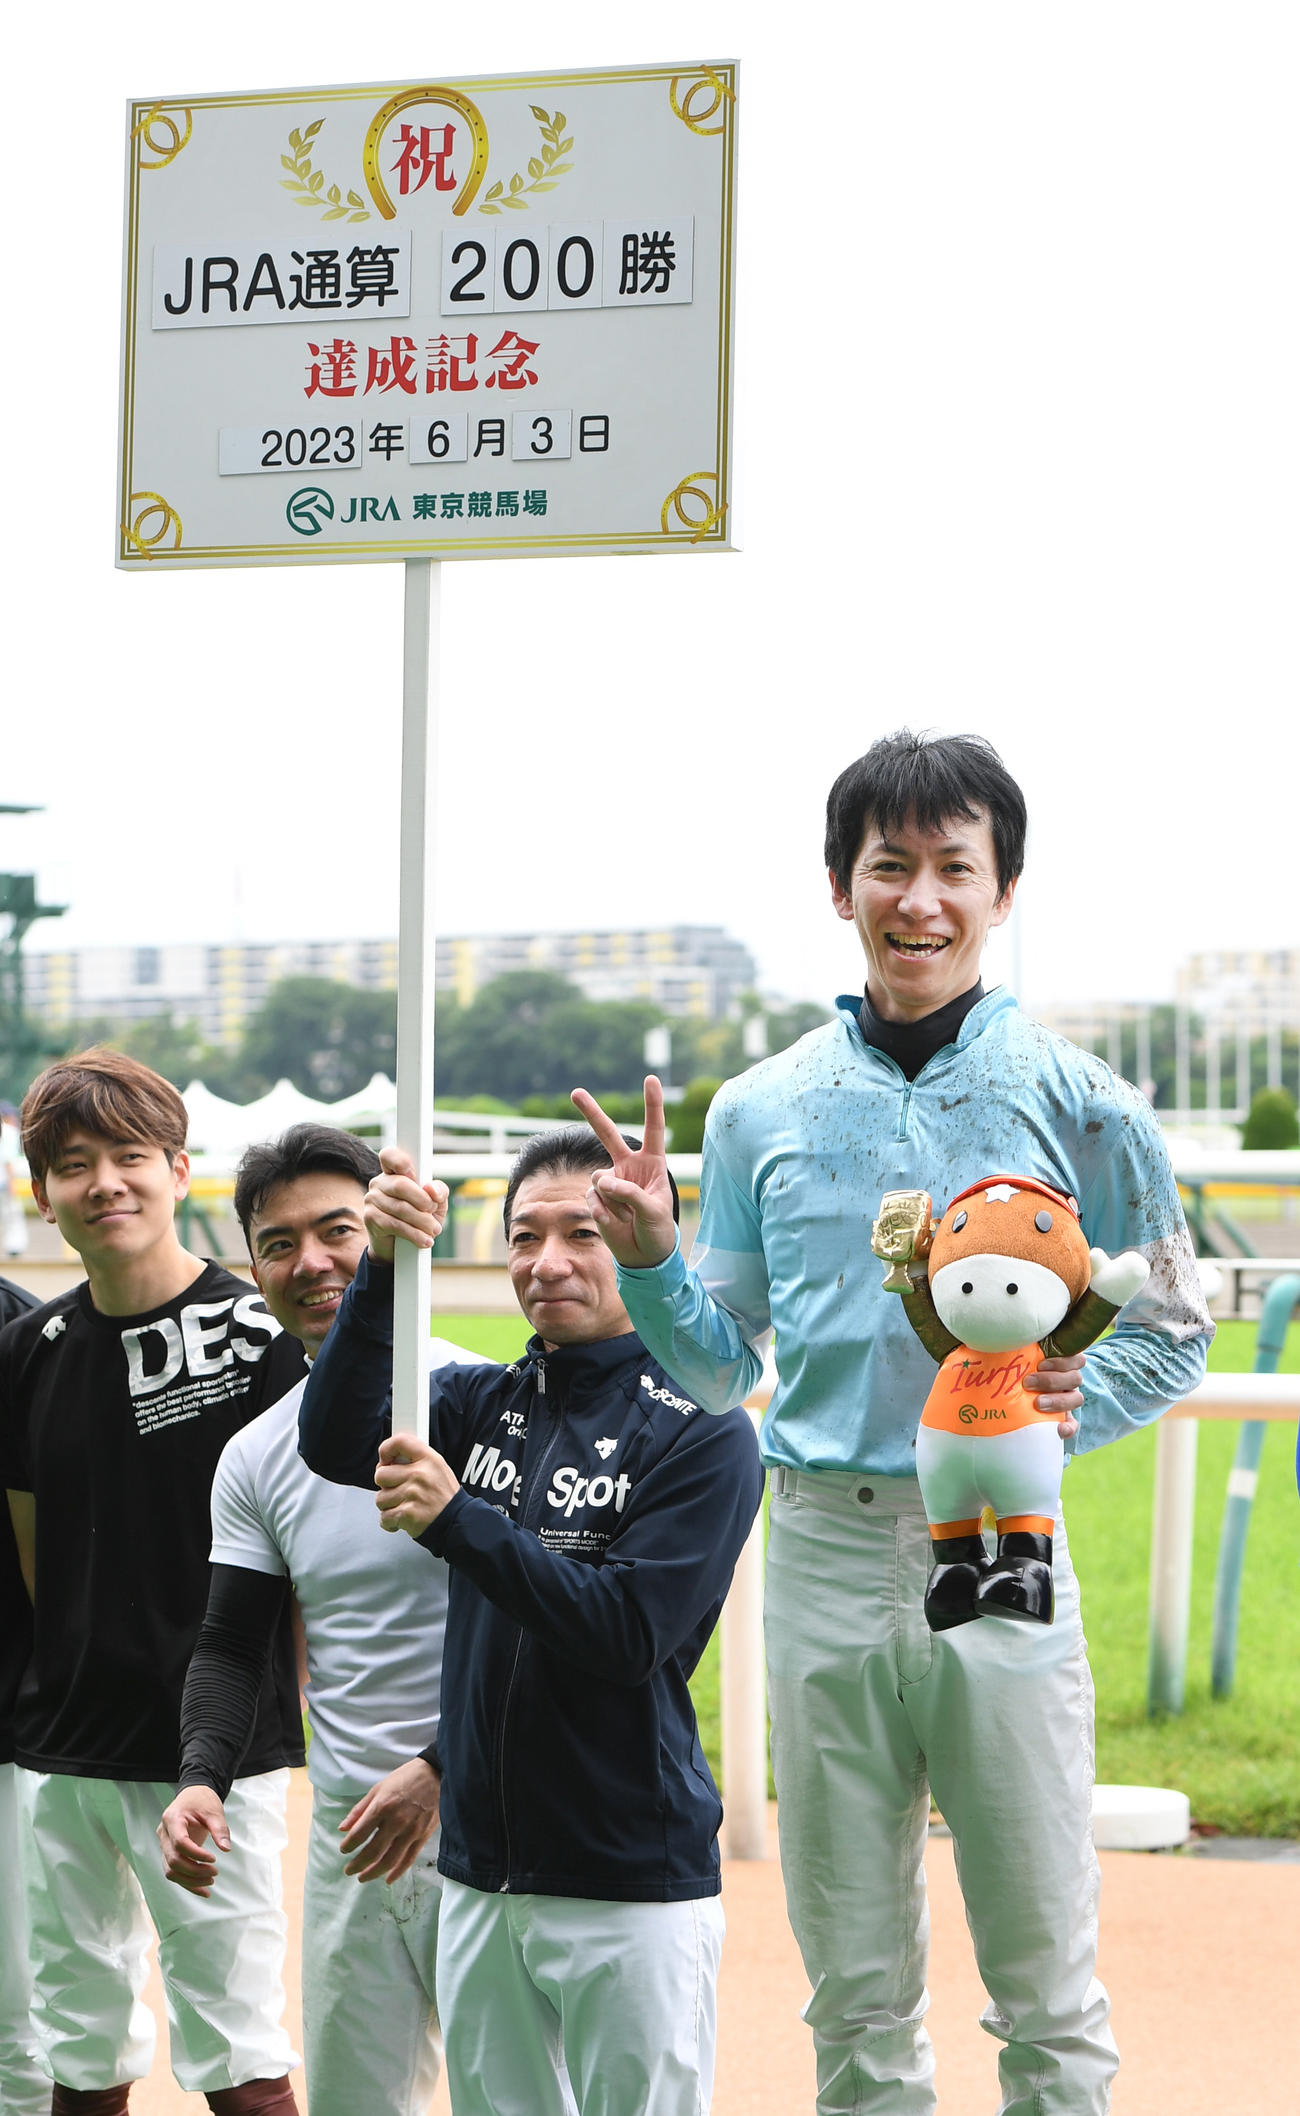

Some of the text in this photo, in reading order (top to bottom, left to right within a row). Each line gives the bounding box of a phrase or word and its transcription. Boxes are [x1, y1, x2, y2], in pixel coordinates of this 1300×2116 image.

[391, 123, 458, 195] 祝
[164, 244, 401, 315] JRA通算
[303, 330, 541, 398] 達成記念
[340, 489, 548, 524] JRA 東京競馬場
[950, 1355, 1031, 1399] Turfy
[980, 1409, 1007, 1420] JRA
[540, 1527, 612, 1540] Universal Func
